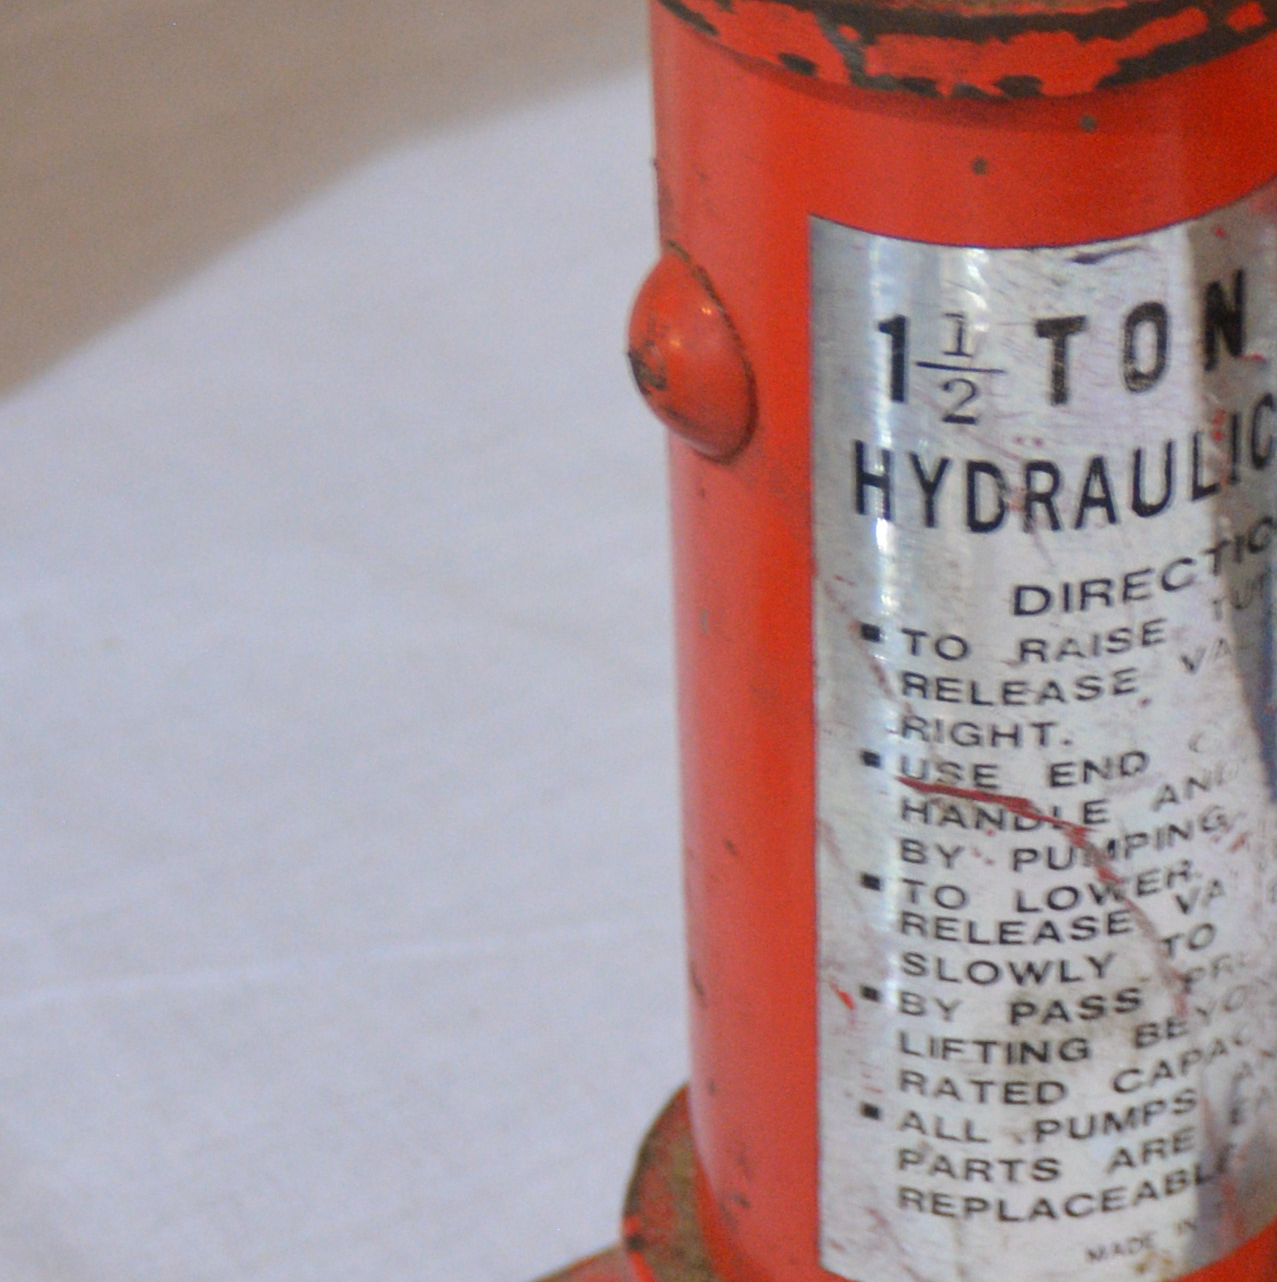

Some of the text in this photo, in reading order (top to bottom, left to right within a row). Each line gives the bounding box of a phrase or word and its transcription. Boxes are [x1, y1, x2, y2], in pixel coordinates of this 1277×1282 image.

[1034, 268, 1248, 405] TON
[852, 393, 1277, 534] HYDRAULIC
[901, 626, 971, 662] TO
[1016, 618, 1170, 663] RAISE
[900, 667, 1141, 707] RELEASE
[900, 716, 1073, 748] RIGHT.
[900, 749, 1150, 791] USE END
[900, 797, 1112, 833] HANDLE
[900, 838, 965, 870] BY
[1011, 803, 1232, 873] PUMPING
[900, 878, 969, 912] TO
[900, 908, 1134, 946] RELEASE
[902, 921, 1218, 987] SLOWLY TO
[898, 990, 962, 1022] BY
[1008, 987, 1146, 1027] PASS
[898, 1030, 1094, 1066] LIFTING
[898, 1069, 1069, 1107] RATED
[898, 1109, 990, 1144] ALL
[1033, 1087, 1198, 1145] PUMPS
[897, 1125, 1197, 1184] PARTS ARE
[1086, 1231, 1157, 1264] MADE
